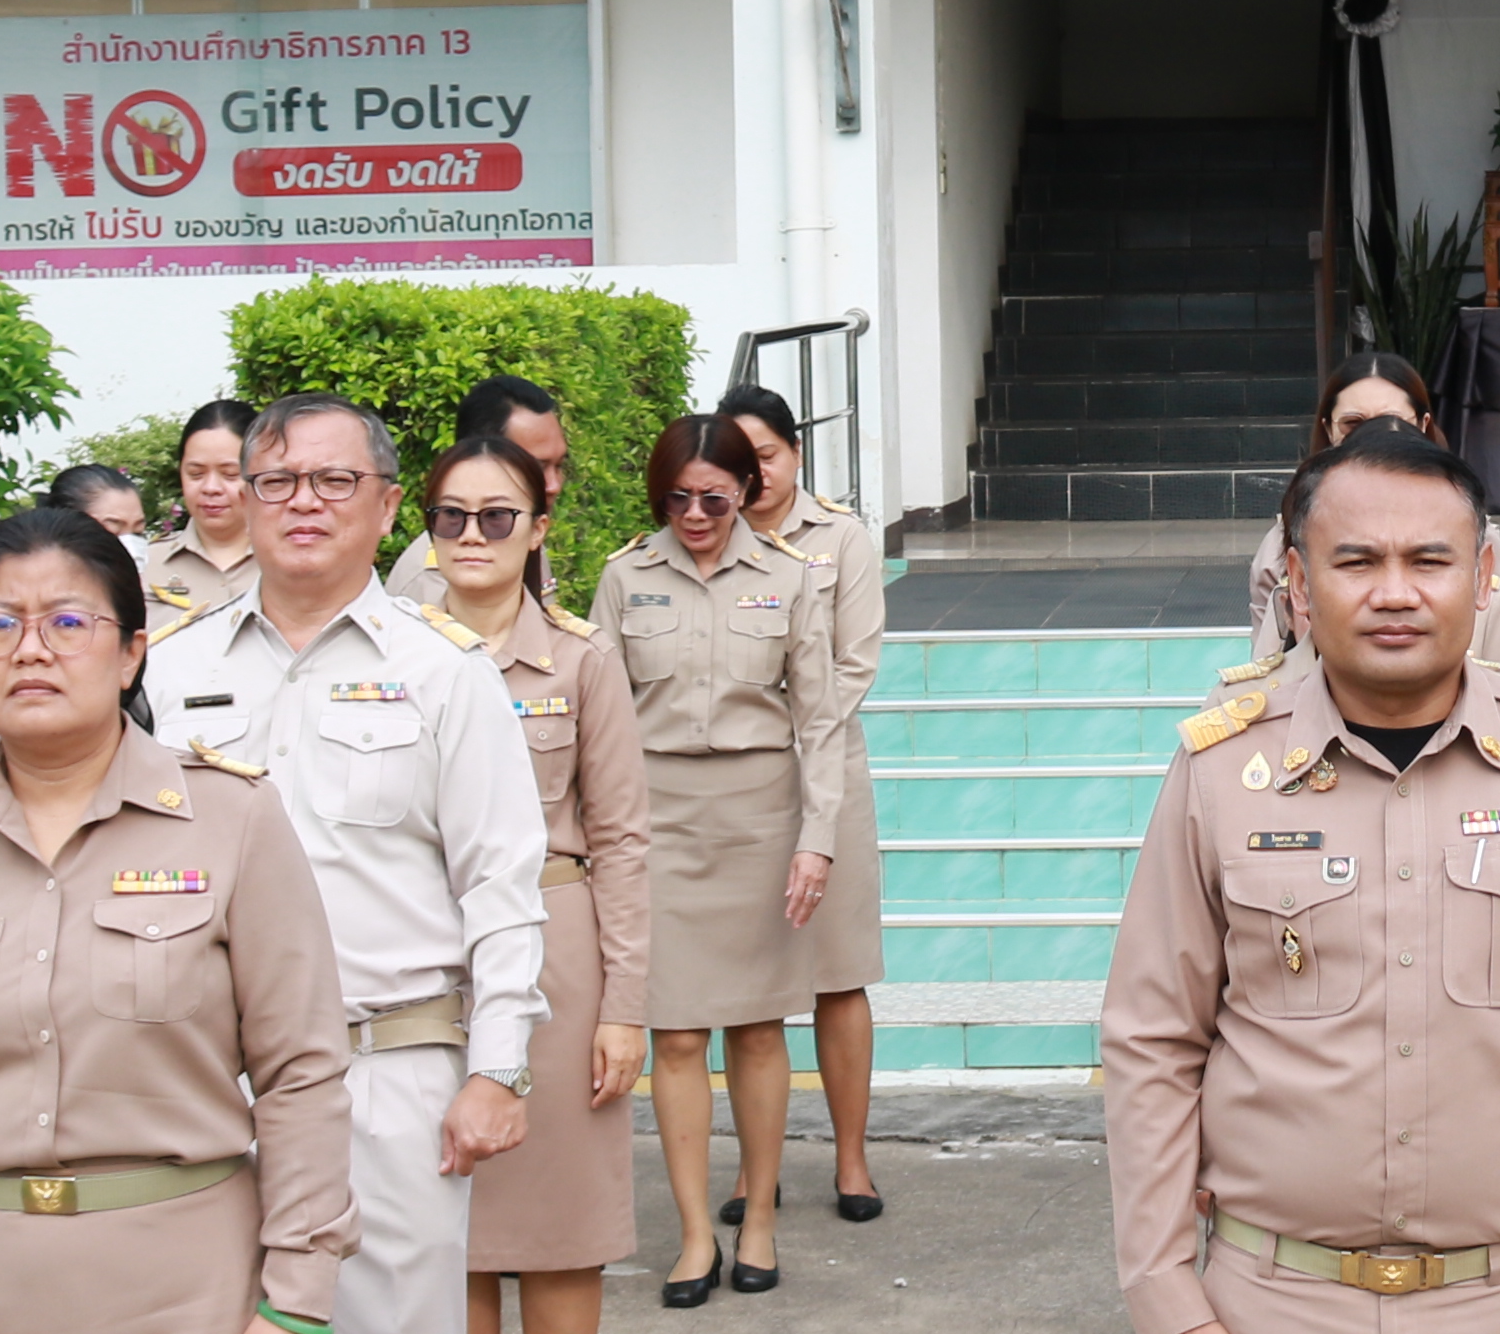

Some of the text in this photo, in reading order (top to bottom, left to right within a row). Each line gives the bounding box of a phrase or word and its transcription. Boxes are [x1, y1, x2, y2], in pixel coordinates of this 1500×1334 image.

[62, 29, 471, 64] สำนักงานศึกษาธิการภาค 13
[221, 84, 531, 138] Gift Policy
[273, 148, 482, 190] งดรับ งดให้
[4, 215, 75, 242] การให้
[85, 207, 162, 240] ไม่รับ
[174, 213, 283, 238] ของขวัญ
[295, 207, 592, 239] และของกำนัลในทุกโอกาส
